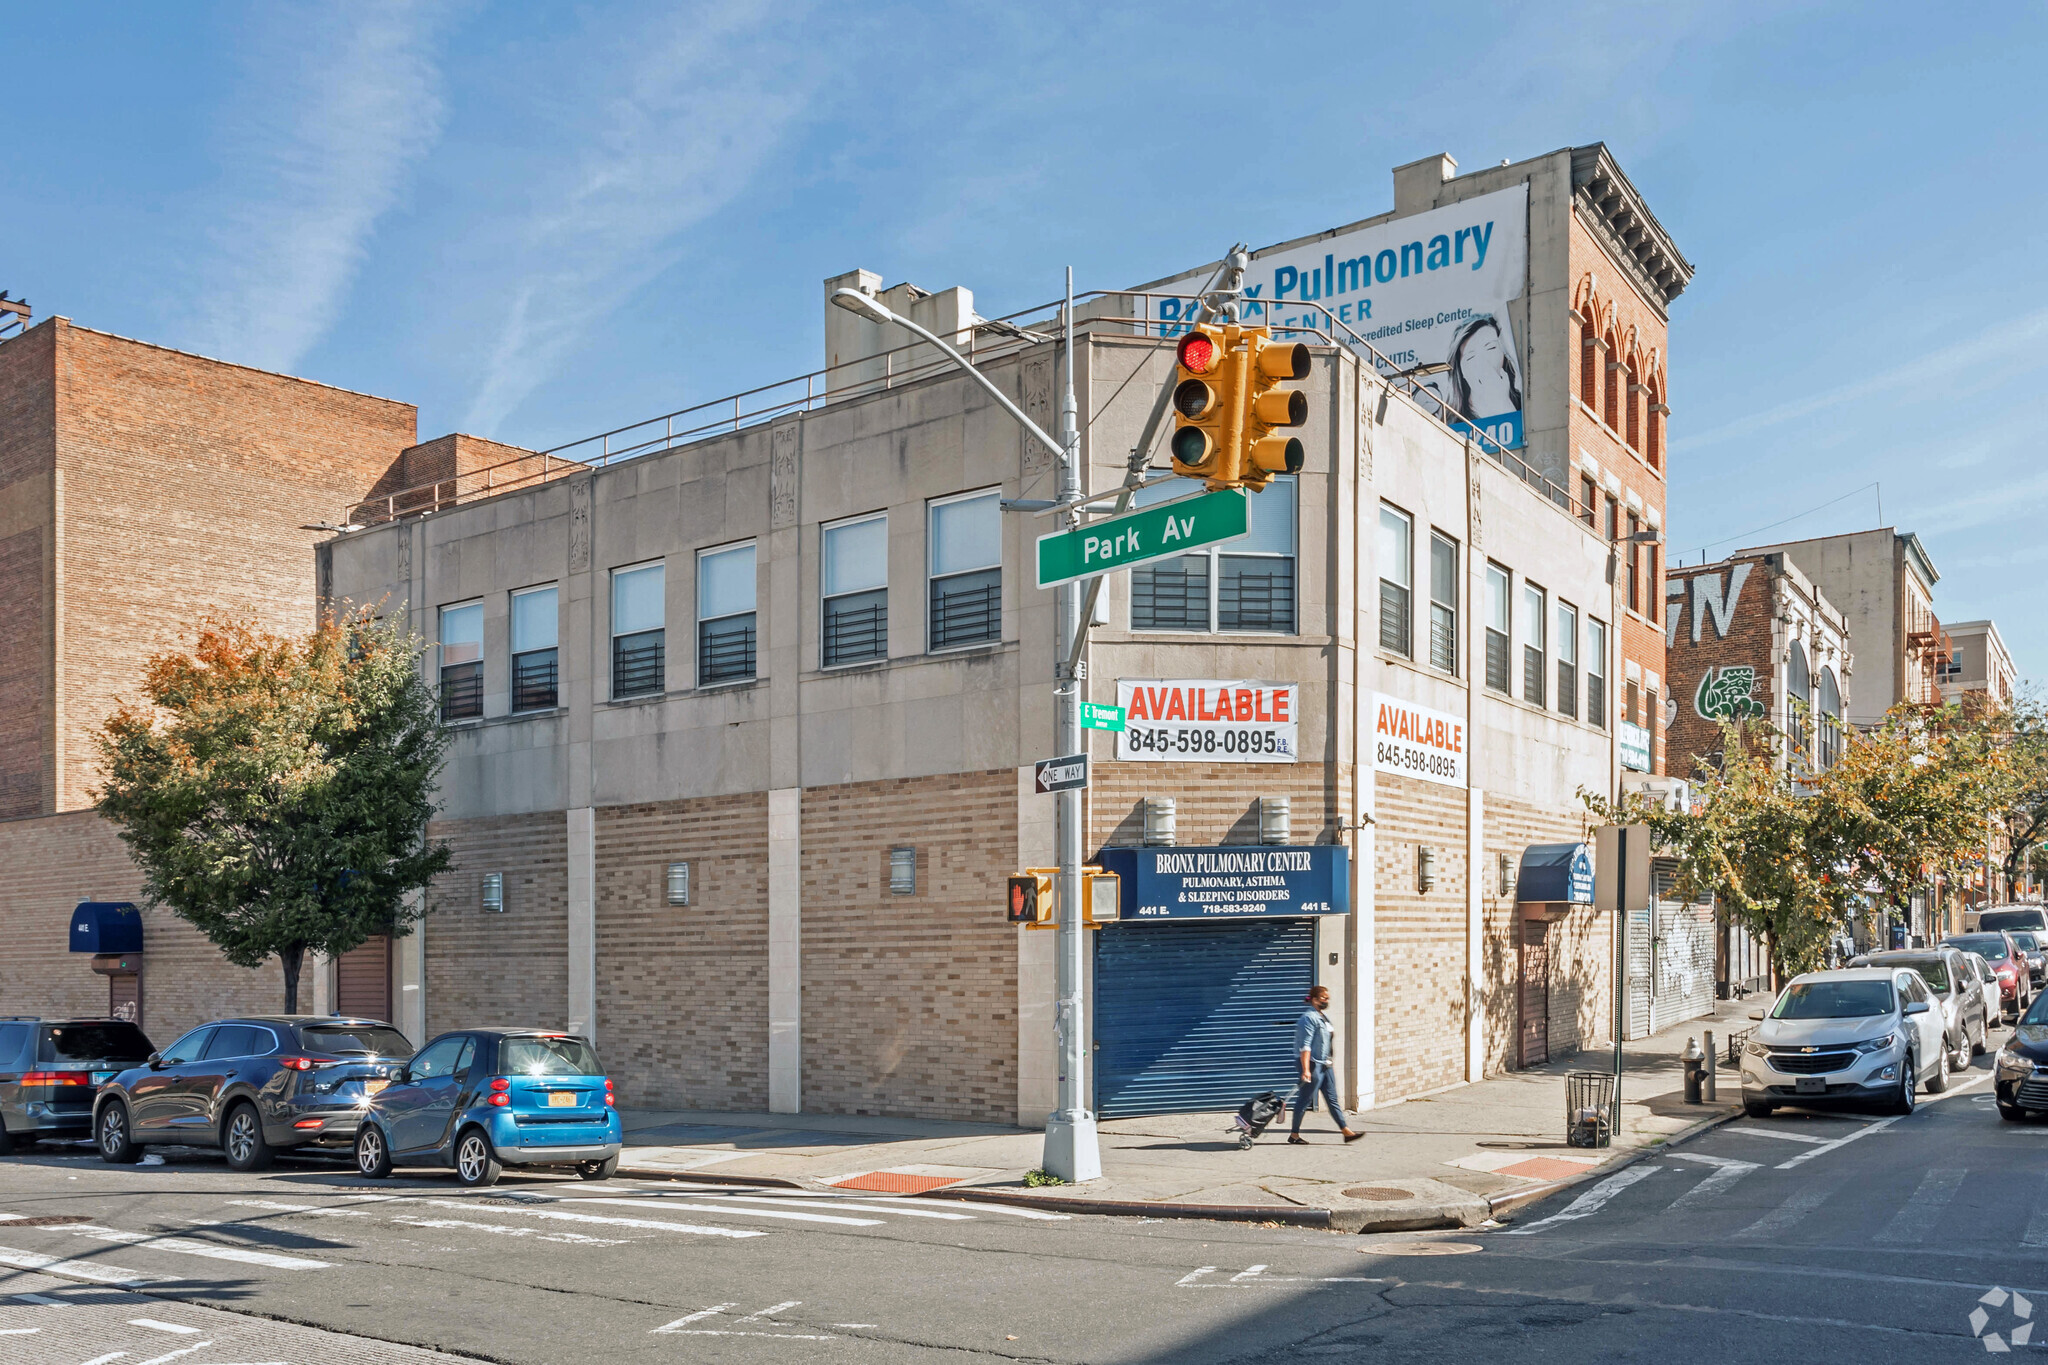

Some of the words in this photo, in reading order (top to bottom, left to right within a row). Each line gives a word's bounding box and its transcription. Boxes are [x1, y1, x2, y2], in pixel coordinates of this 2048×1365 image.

[1160, 284, 1263, 338] Brx
[1275, 221, 1494, 310] Pulmonary
[1405, 317, 1434, 333] Sleep
[1437, 308, 1472, 325] Center
[1084, 527, 1140, 564] Park
[1162, 515, 1195, 544] Av
[1084, 704, 1090, 718] E
[1091, 705, 1119, 721] Tremont
[1127, 687, 1289, 723] AVAILABLE
[1377, 703, 1462, 753] AVAILABLE
[1129, 729, 1276, 754] 845-598-0895
[1377, 742, 1456, 778] 845-598-0895
[1043, 768, 1058, 783] ONE
[1064, 765, 1081, 780] WAY
[1156, 853, 1195, 874] BRONX
[1197, 852, 1267, 873] PULMONARY
[1267, 851, 1311, 872] CENTER
[1182, 876, 1245, 888] PULMONARY,
[1245, 875, 1286, 887] ASTHMA
[1178, 891, 1187, 902] &
[1187, 890, 1236, 902] SLEEPING
[1236, 889, 1290, 902] DISORDERS
[1301, 902, 1319, 911] 441
[1321, 902, 1331, 911] E.
[1139, 906, 1157, 915] 441
[1160, 906, 1170, 915] E.
[1202, 903, 1266, 914] 718-583-9240
